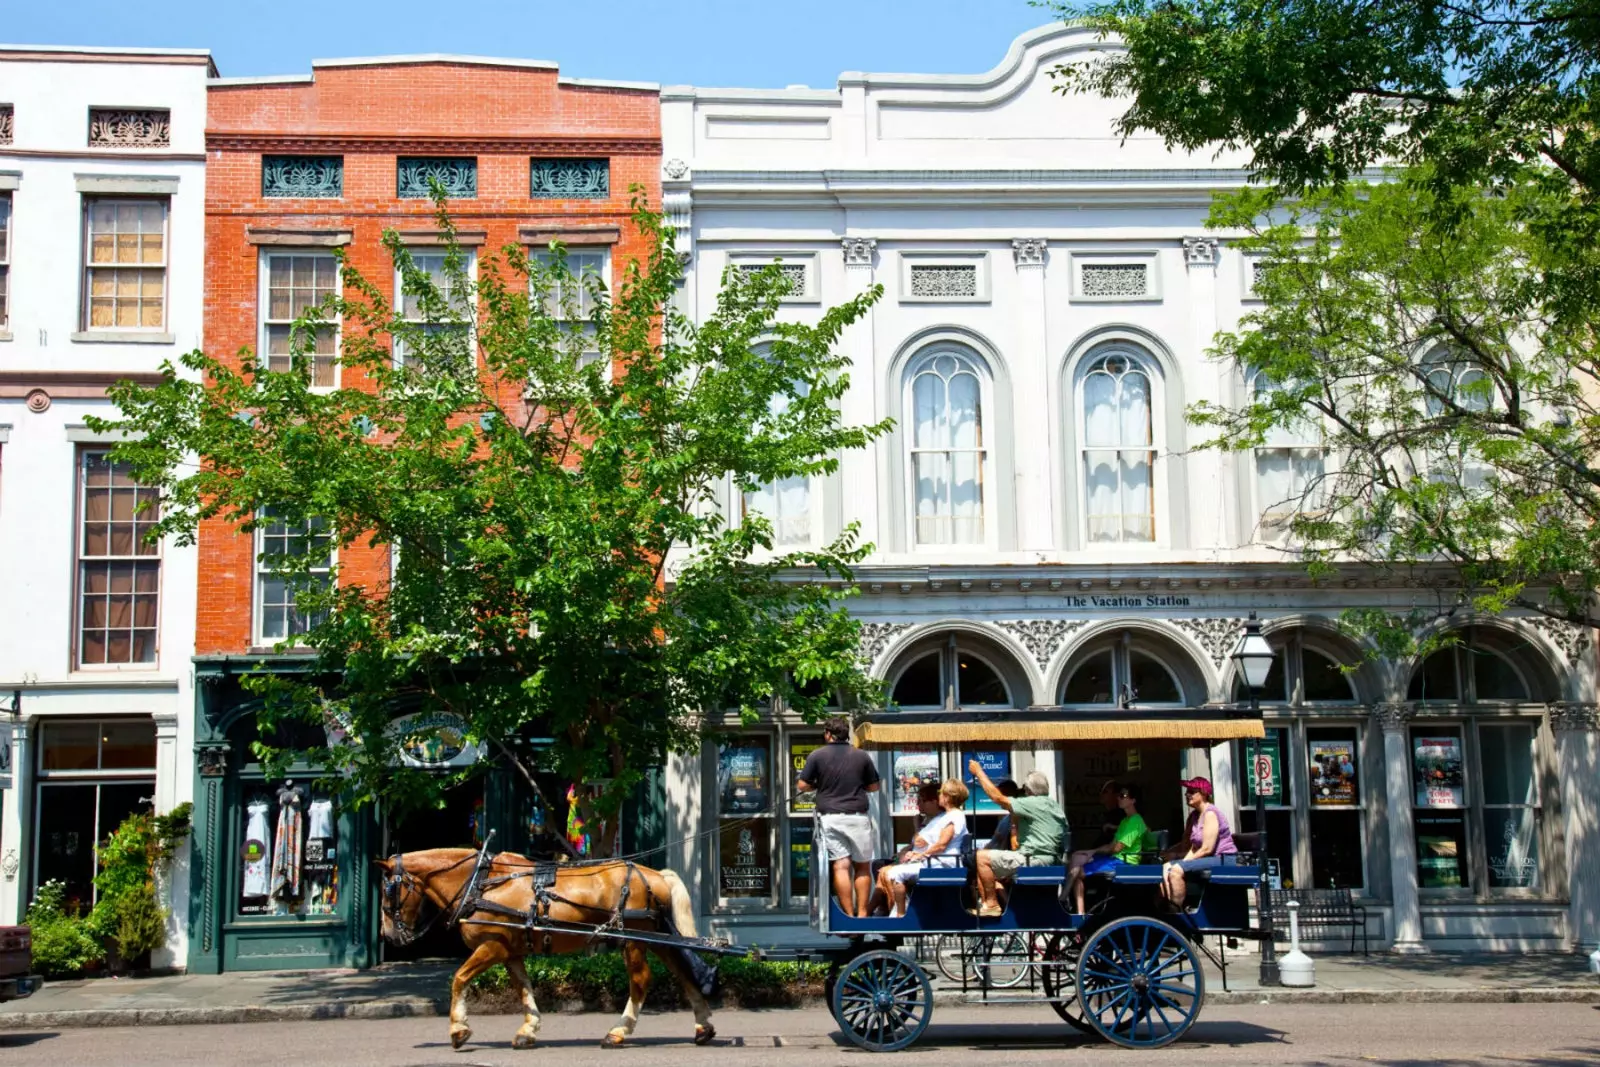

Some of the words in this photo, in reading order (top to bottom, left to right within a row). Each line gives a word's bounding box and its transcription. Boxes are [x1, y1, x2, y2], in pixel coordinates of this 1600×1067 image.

[1065, 596, 1087, 607] The
[1091, 595, 1142, 607] Vacation
[1146, 595, 1190, 606] Station
[1490, 856, 1537, 865] VACION
[722, 867, 769, 875] VACATION
[725, 879, 765, 887] STATION
